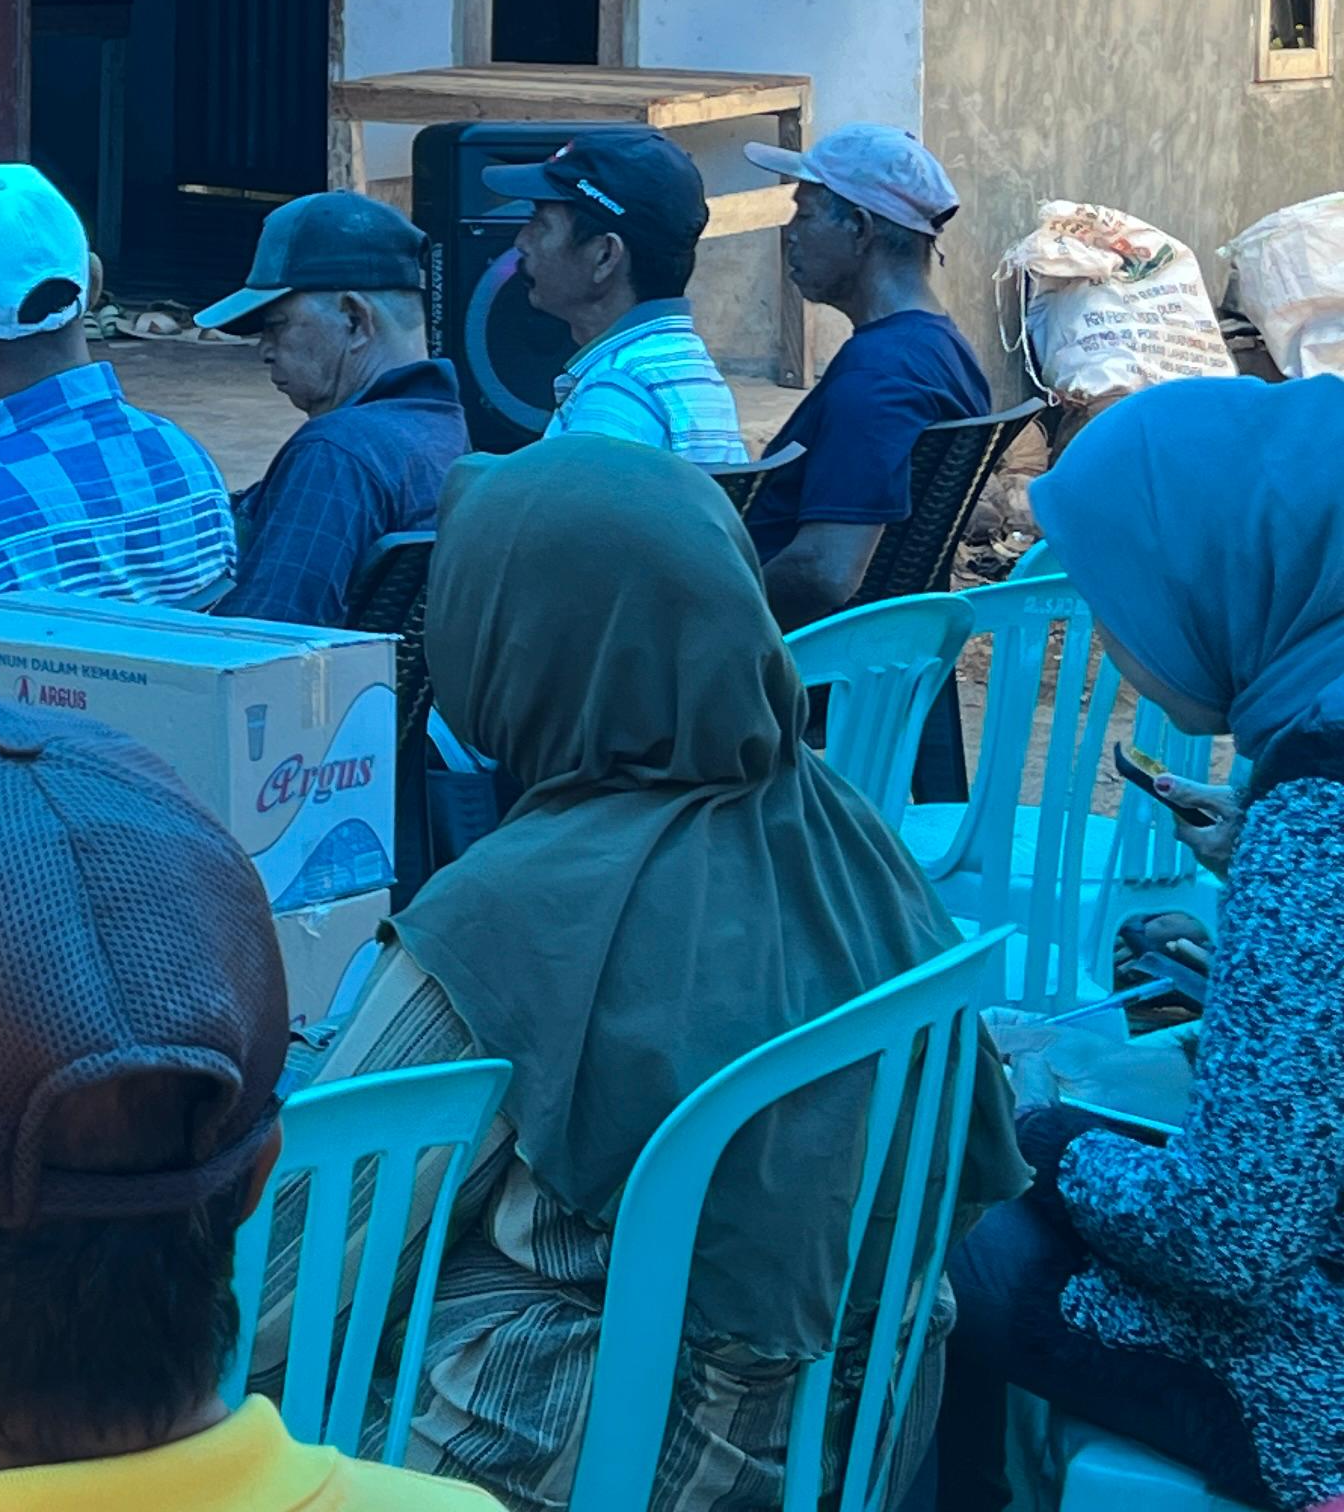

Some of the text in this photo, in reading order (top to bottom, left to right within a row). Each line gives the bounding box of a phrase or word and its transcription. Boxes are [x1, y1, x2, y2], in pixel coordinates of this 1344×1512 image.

[31, 658, 78, 676] DALAM
[81, 664, 148, 686] KEMASAN
[39, 685, 87, 710] ARGUS
[256, 753, 376, 813] Argus
